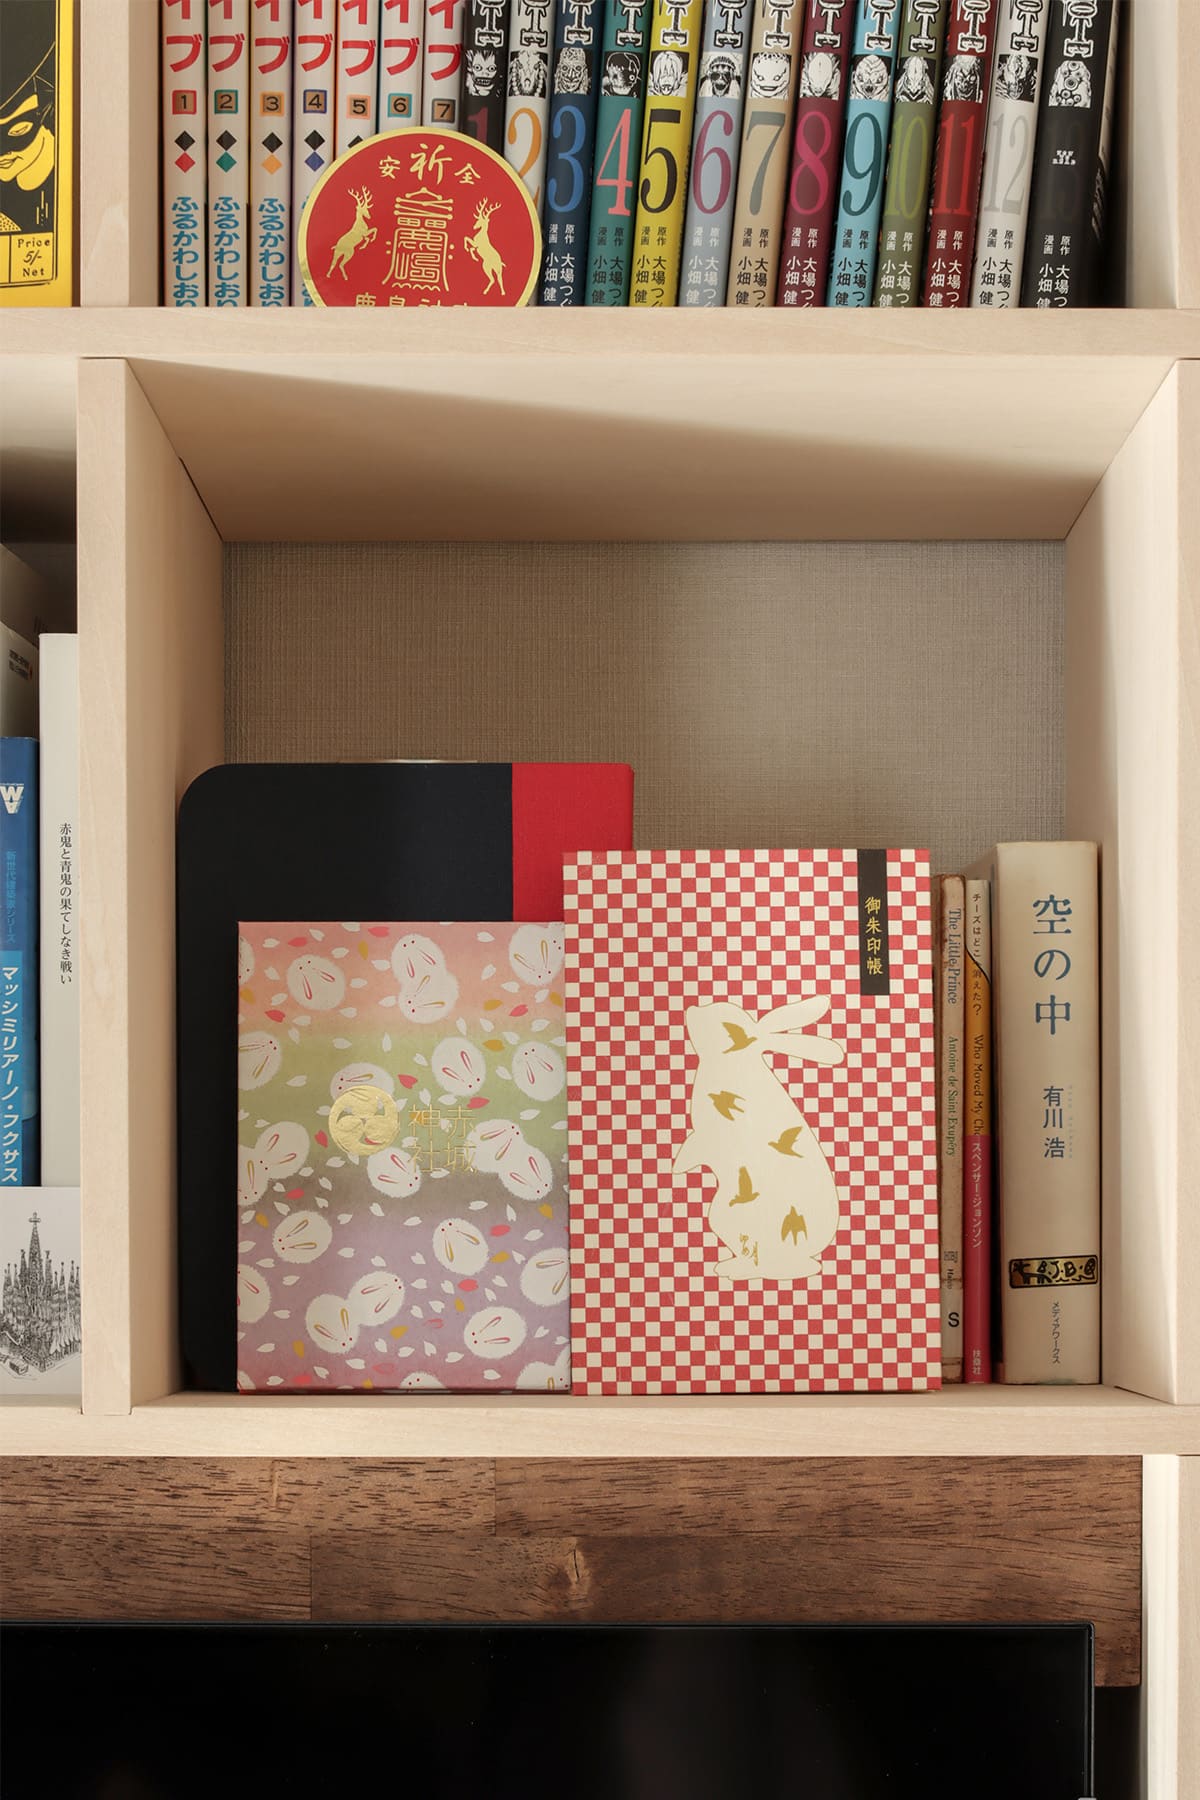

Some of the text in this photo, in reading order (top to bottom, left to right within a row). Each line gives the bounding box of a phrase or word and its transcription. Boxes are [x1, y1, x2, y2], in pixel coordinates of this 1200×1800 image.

[180, 94, 188, 109] 1
[219, 94, 233, 109] 2
[266, 96, 279, 111] 3
[308, 94, 322, 108] 4
[352, 100, 366, 115] 5
[394, 98, 407, 112] 6
[438, 103, 451, 118] 7
[507, 107, 542, 209] 2
[549, 105, 586, 212] 3
[596, 108, 633, 216] 4
[640, 109, 681, 213] 5
[692, 110, 733, 214] 6
[745, 111, 786, 216] 7
[790, 111, 832, 215] 8
[842, 112, 883, 216] 9
[884, 113, 928, 219] 10
[933, 113, 976, 215] 11
[984, 112, 1030, 215] 12
[17, 237, 50, 248] Price
[23, 267, 44, 277] Net
[852, 259, 868, 307] 大場つ
[946, 260, 962, 307] 大場つ
[997, 259, 1012, 307] 大場つ
[60, 823, 72, 985] 赤鬼と青鬼の果てしなき戦い
[865, 897, 883, 975] 御朱印帳
[948, 908, 961, 1005] The Little Prince
[1032, 894, 1073, 1035] 空の中
[948, 1036, 959, 1073] Antoine
[973, 1034, 985, 1060] Who
[1, 967, 20, 1183] マッシミリアーノ・フクサス
[948, 1076, 958, 1087] de
[973, 1063, 984, 1097] Moved
[971, 1100, 983, 1116] My
[948, 1312, 960, 1328] S
